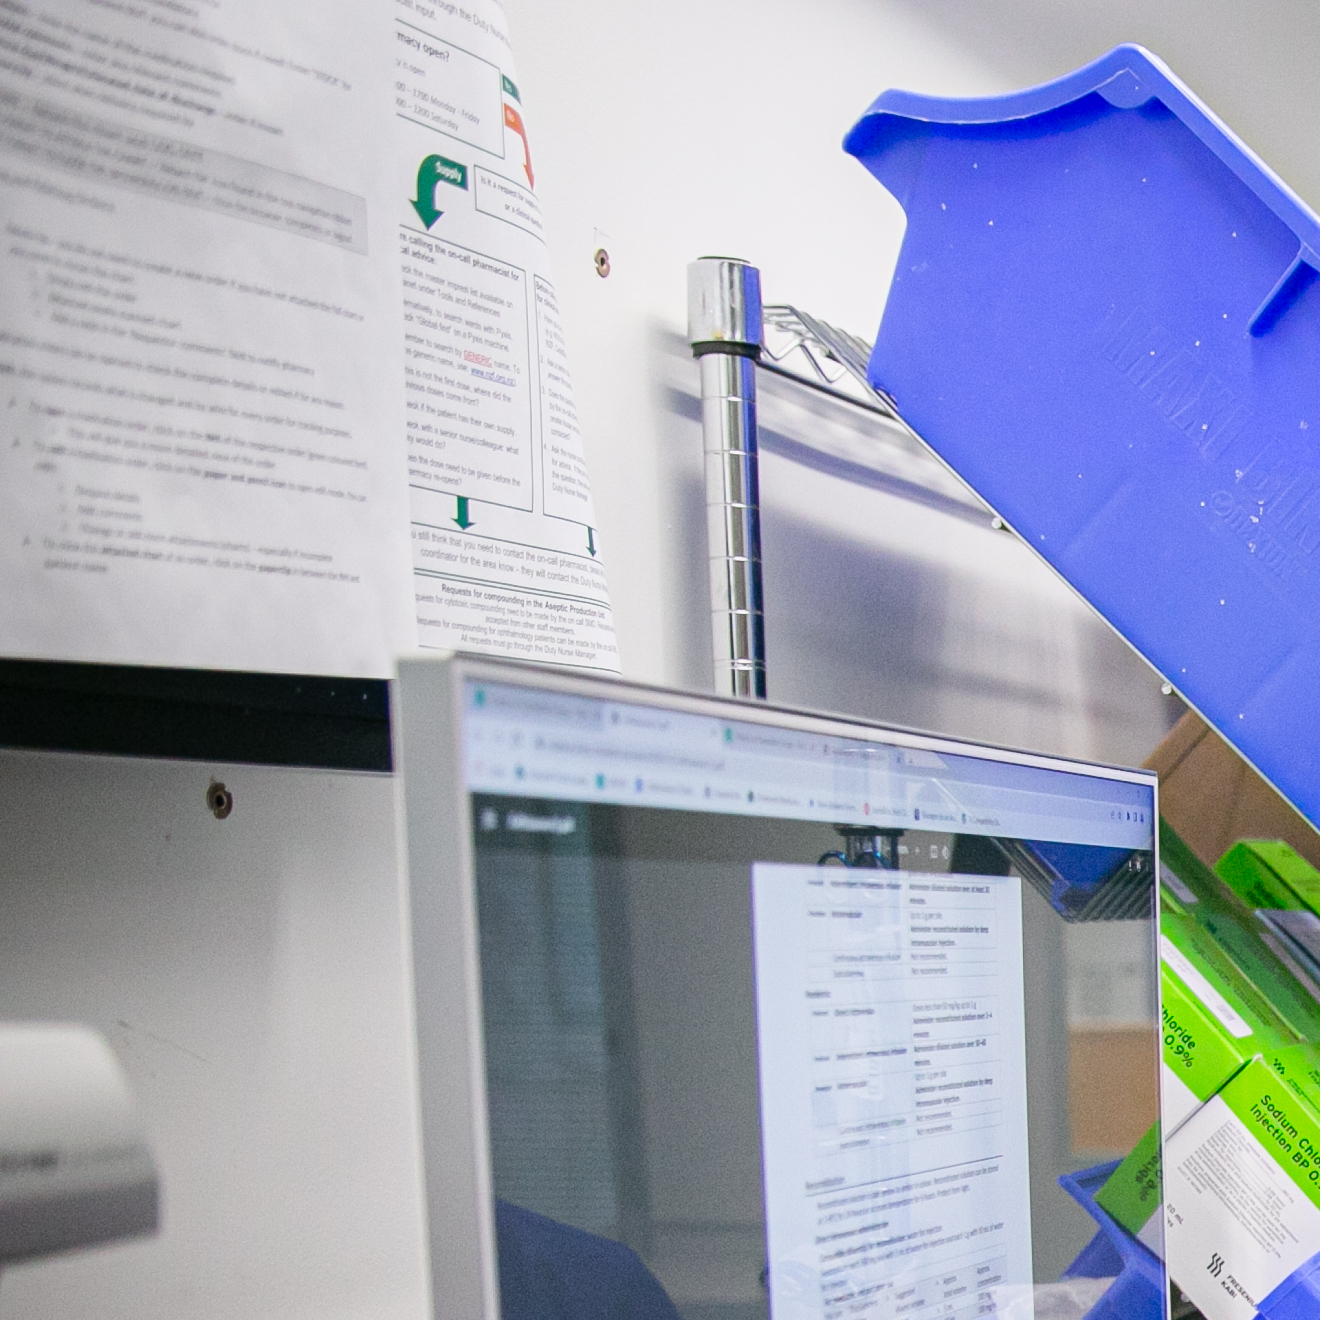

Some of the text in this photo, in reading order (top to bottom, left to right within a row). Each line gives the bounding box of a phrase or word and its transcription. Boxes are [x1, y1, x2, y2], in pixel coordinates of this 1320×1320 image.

[423, 44, 450, 62] open?
[435, 161, 462, 183] Supply
[409, 236, 519, 281] calling the on-call pharmacist for
[431, 533, 447, 545] think
[449, 536, 462, 547] that
[463, 541, 476, 550] you
[477, 543, 494, 553] need
[495, 545, 501, 554] to
[526, 551, 535, 561] the
[460, 554, 469, 563] for
[471, 556, 481, 566] the
[482, 560, 496, 569] area
[521, 565, 534, 578] they
[442, 583, 597, 617] Requests for compounding in the Aseptic Production
[452, 622, 487, 635] compounding
[535, 644, 543, 652] the
[544, 645, 557, 656] Duty
[558, 648, 574, 656] Nurse
[1161, 1005, 1196, 1050] hloride
[1163, 1034, 1193, 1069] 0.9%
[1261, 1096, 1300, 1139] Sodium
[1249, 1104, 1294, 1153] Injection
[1292, 1153, 1309, 1171] BP
[1220, 1281, 1237, 1298] KABI
